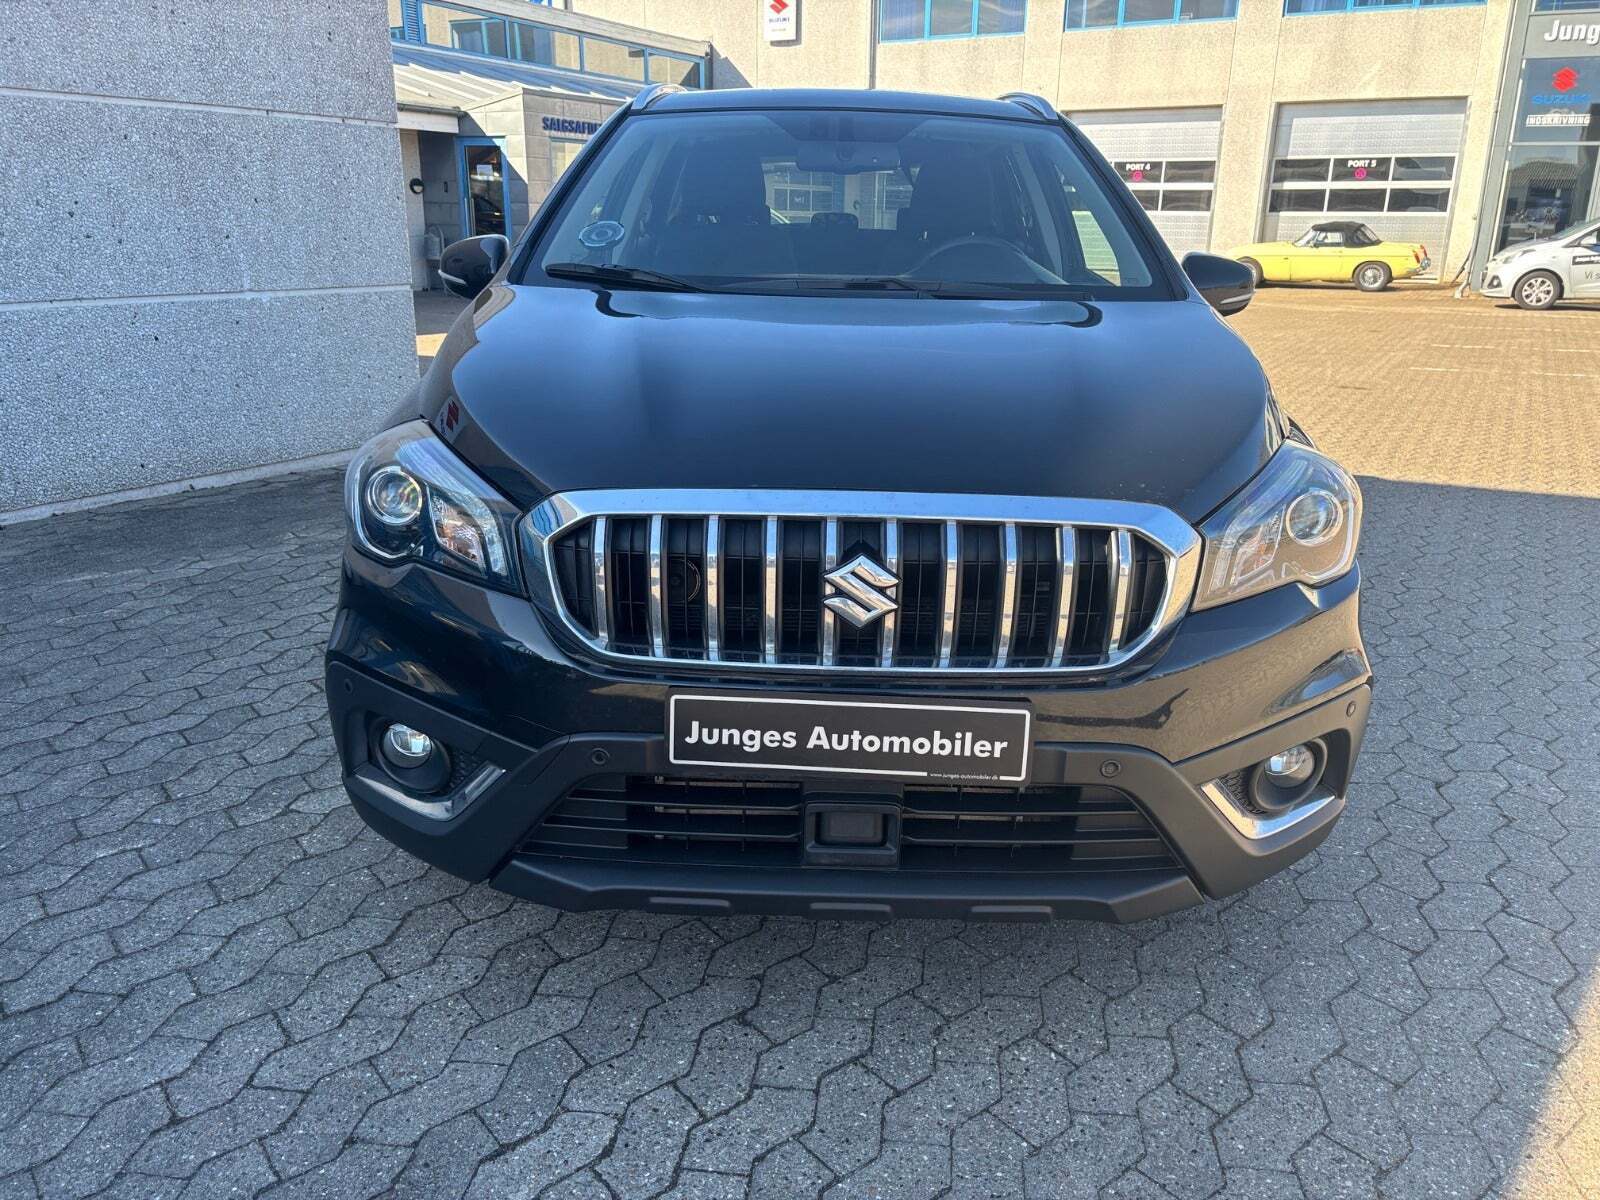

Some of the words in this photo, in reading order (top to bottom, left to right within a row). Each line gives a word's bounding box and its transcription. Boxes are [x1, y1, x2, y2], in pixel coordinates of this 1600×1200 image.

[1532, 95, 1591, 105] SUZUKI
[1125, 163, 1145, 171] PORT
[1145, 163, 1151, 171] 4
[1347, 159, 1370, 168] PORT
[685, 720, 797, 753] Junges
[806, 726, 1009, 758] Automobiler
